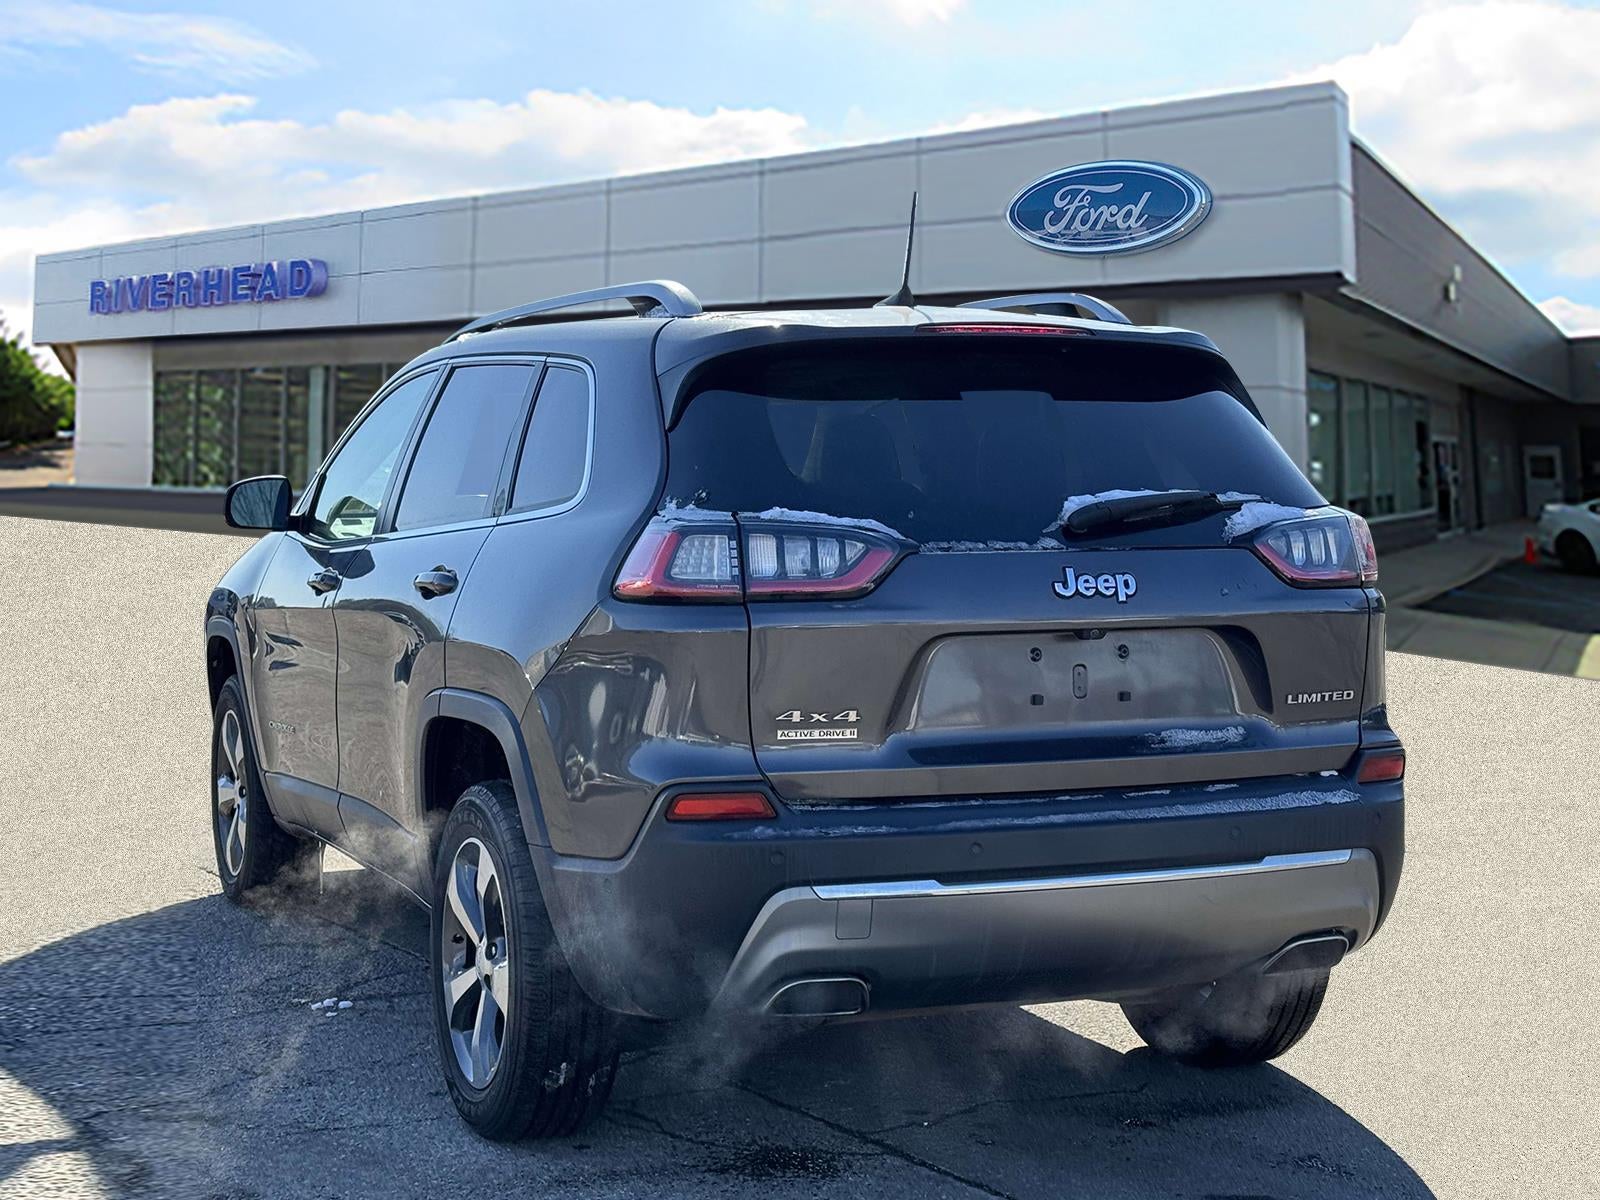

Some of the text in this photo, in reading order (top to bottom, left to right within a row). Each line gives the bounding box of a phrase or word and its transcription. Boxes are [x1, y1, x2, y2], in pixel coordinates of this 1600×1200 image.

[1043, 183, 1152, 234] Ford
[89, 258, 327, 315] RIVERHEAD
[1053, 566, 1138, 603] Jeep
[1287, 690, 1355, 705] LIMITED
[779, 730, 816, 738] ACTIVE
[818, 729, 848, 738] DRIVE
